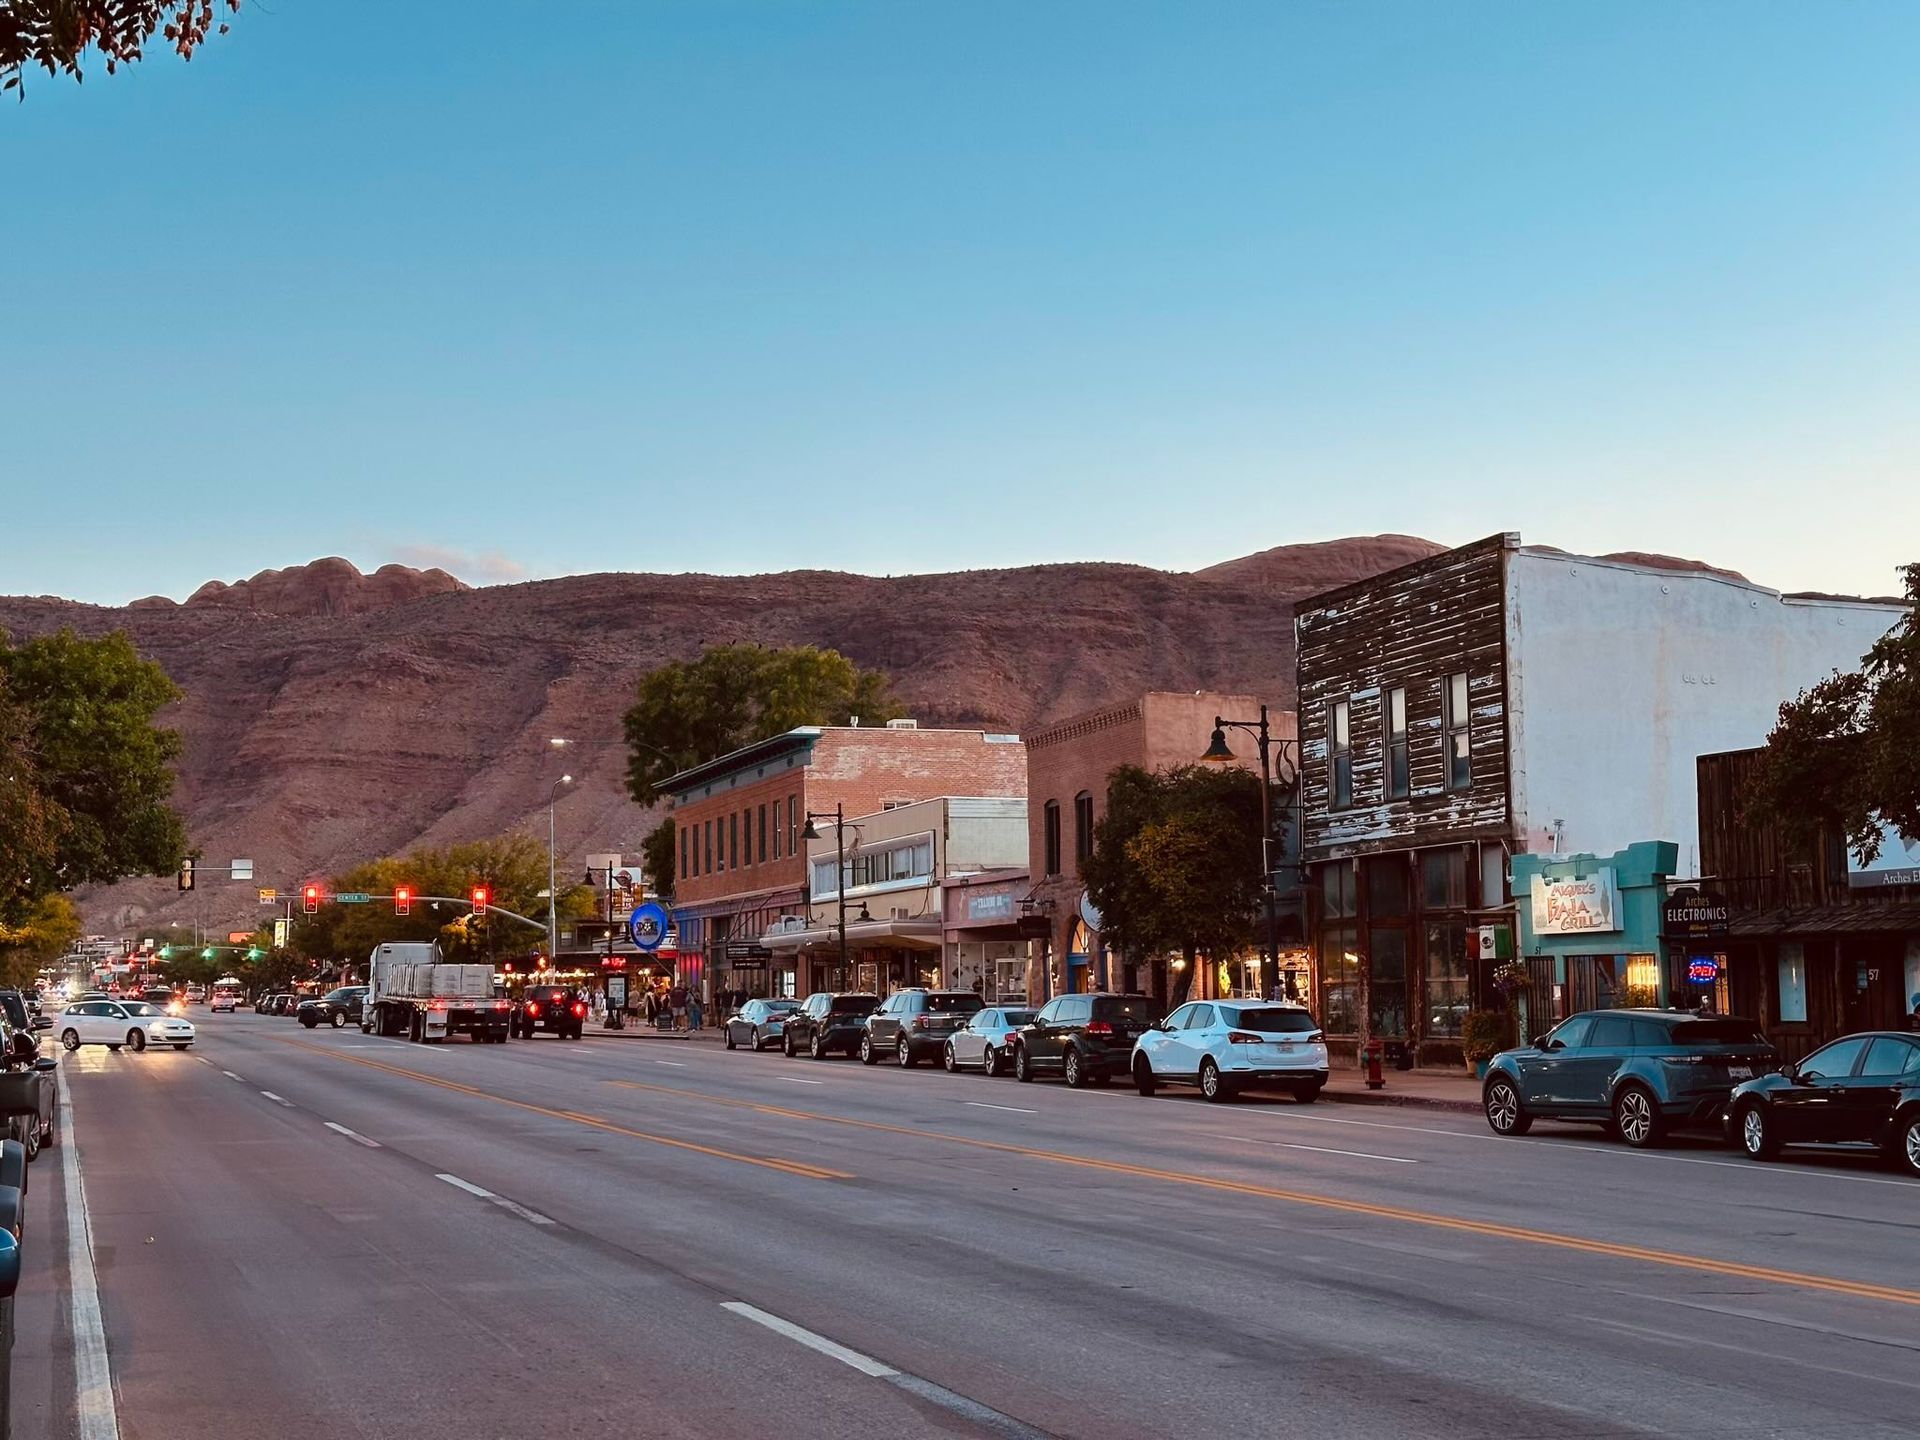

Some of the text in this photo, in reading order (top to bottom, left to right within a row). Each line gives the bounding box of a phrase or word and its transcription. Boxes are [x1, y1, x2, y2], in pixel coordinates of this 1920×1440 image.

[1882, 871, 1911, 885] Arches
[1686, 896, 1710, 907] Arches
[1547, 897, 1590, 924] BAJA
[1667, 907, 1727, 922] ELECTRONICS
[1561, 915, 1602, 931] GRILL
[1868, 968, 1880, 981] 57
